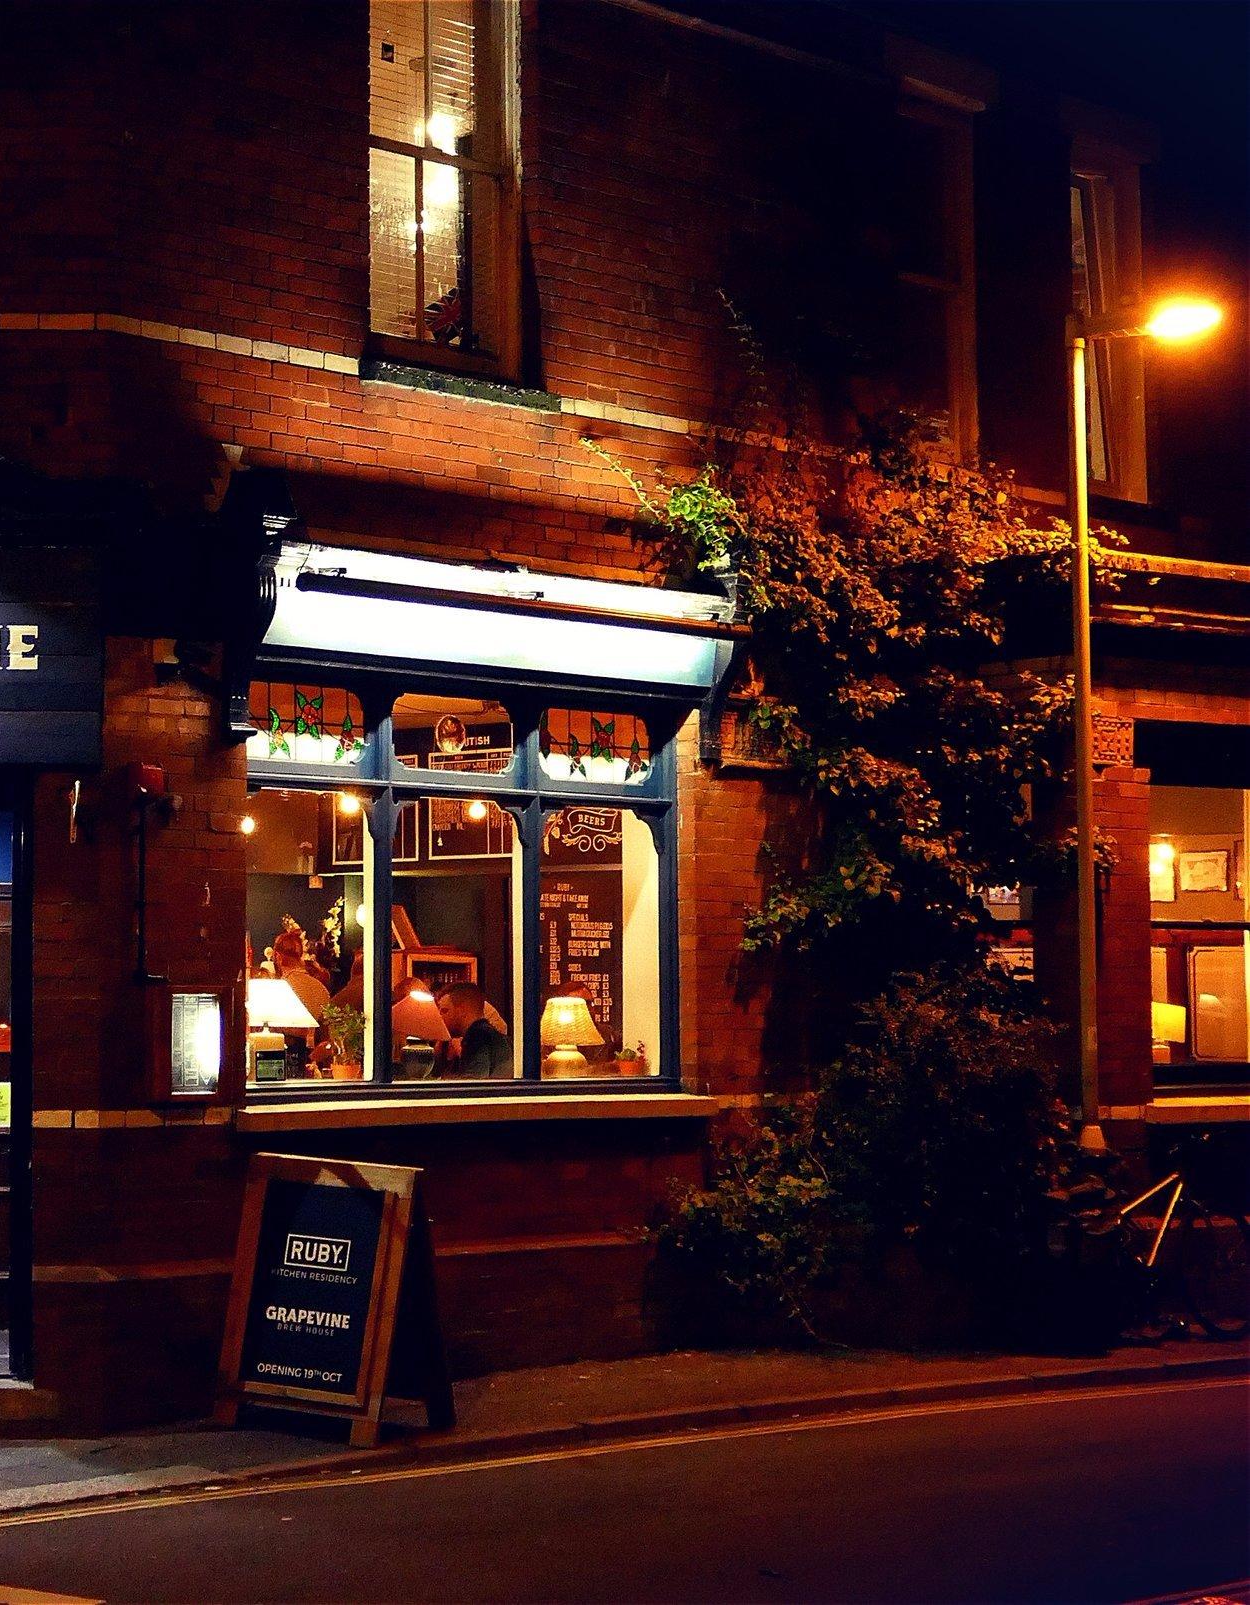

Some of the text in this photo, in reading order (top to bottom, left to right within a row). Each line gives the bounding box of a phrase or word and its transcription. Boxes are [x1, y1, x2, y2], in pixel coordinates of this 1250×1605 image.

[578, 814, 606, 826] BEERS
[290, 1240, 344, 1265] RUBY.
[271, 1268, 358, 1285] KITCHEN RESIDENCY
[265, 1306, 351, 1330] GRAPEVINE
[277, 1322, 335, 1337] BREW HOUSE
[257, 1362, 302, 1378] OPENING
[322, 1371, 343, 1382] OCT
